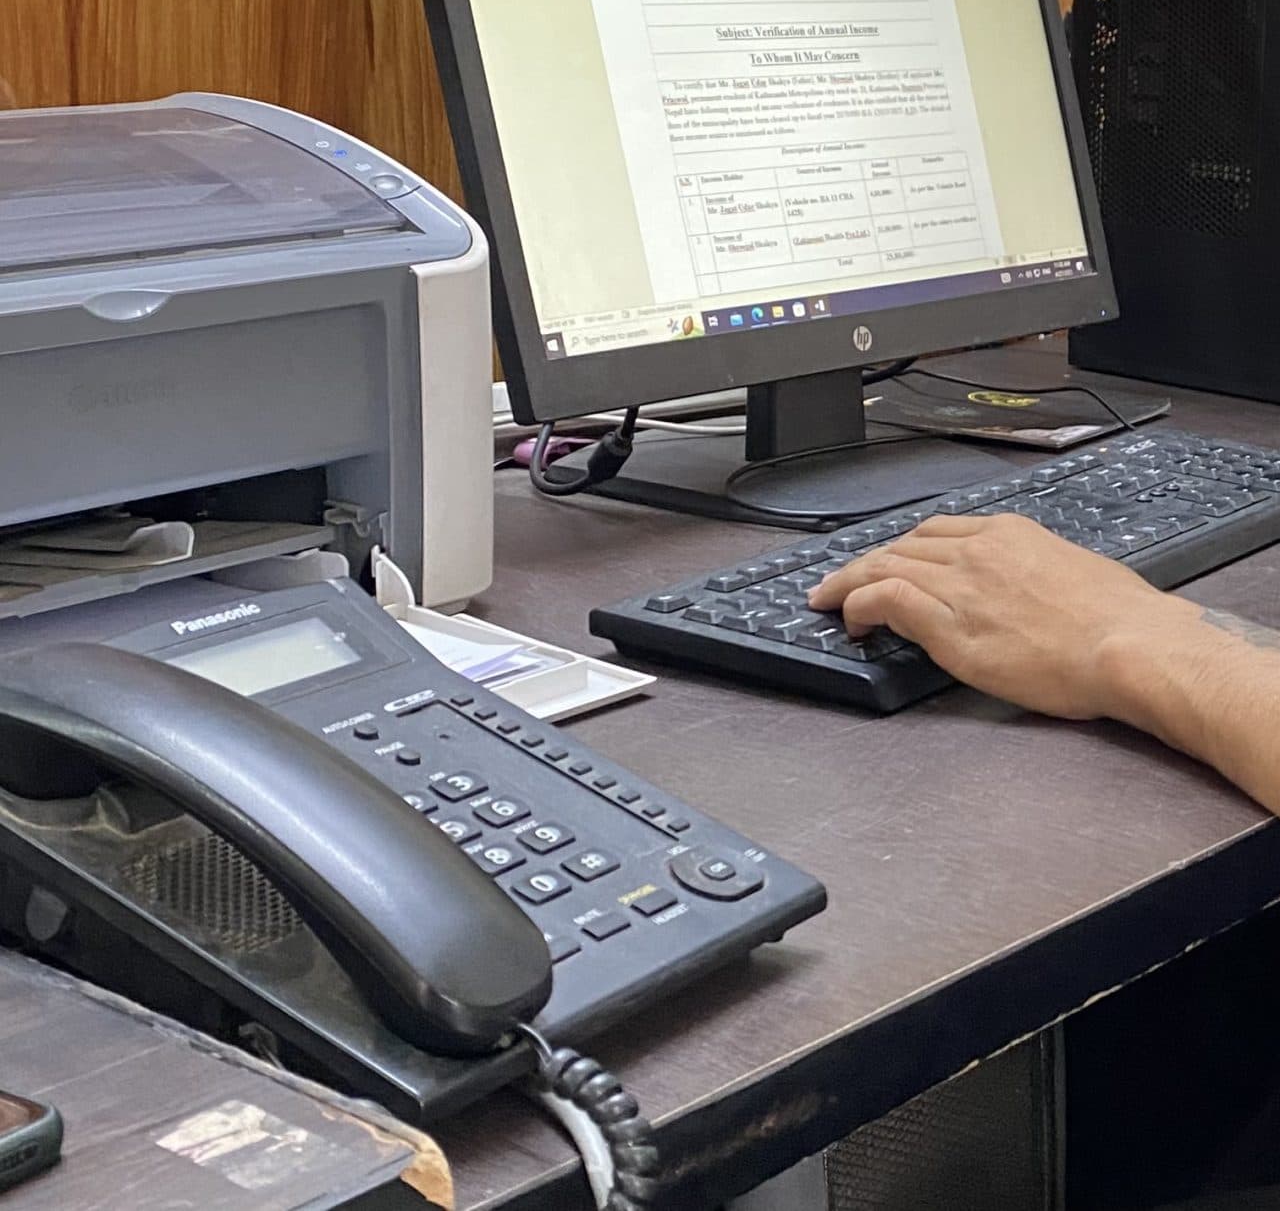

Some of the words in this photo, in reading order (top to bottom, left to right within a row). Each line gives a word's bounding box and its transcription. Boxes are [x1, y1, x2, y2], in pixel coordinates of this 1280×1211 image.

[715, 27, 753, 40] Subject:
[755, 25, 806, 38] Verification
[807, 25, 816, 37] of
[818, 24, 848, 36] Annual
[850, 23, 879, 35] Income
[750, 54, 763, 64] To
[764, 52, 793, 64] Whom
[794, 52, 802, 63] It
[803, 51, 823, 64] May
[825, 50, 860, 62] Concern
[854, 325, 872, 351] hp
[170, 602, 261, 635] Panasonic
[447, 776, 473, 791] 3
[491, 800, 517, 816] 6
[440, 821, 467, 838] 5
[535, 826, 561, 843] 9
[484, 847, 511, 865] 8
[529, 874, 556, 892] 0
